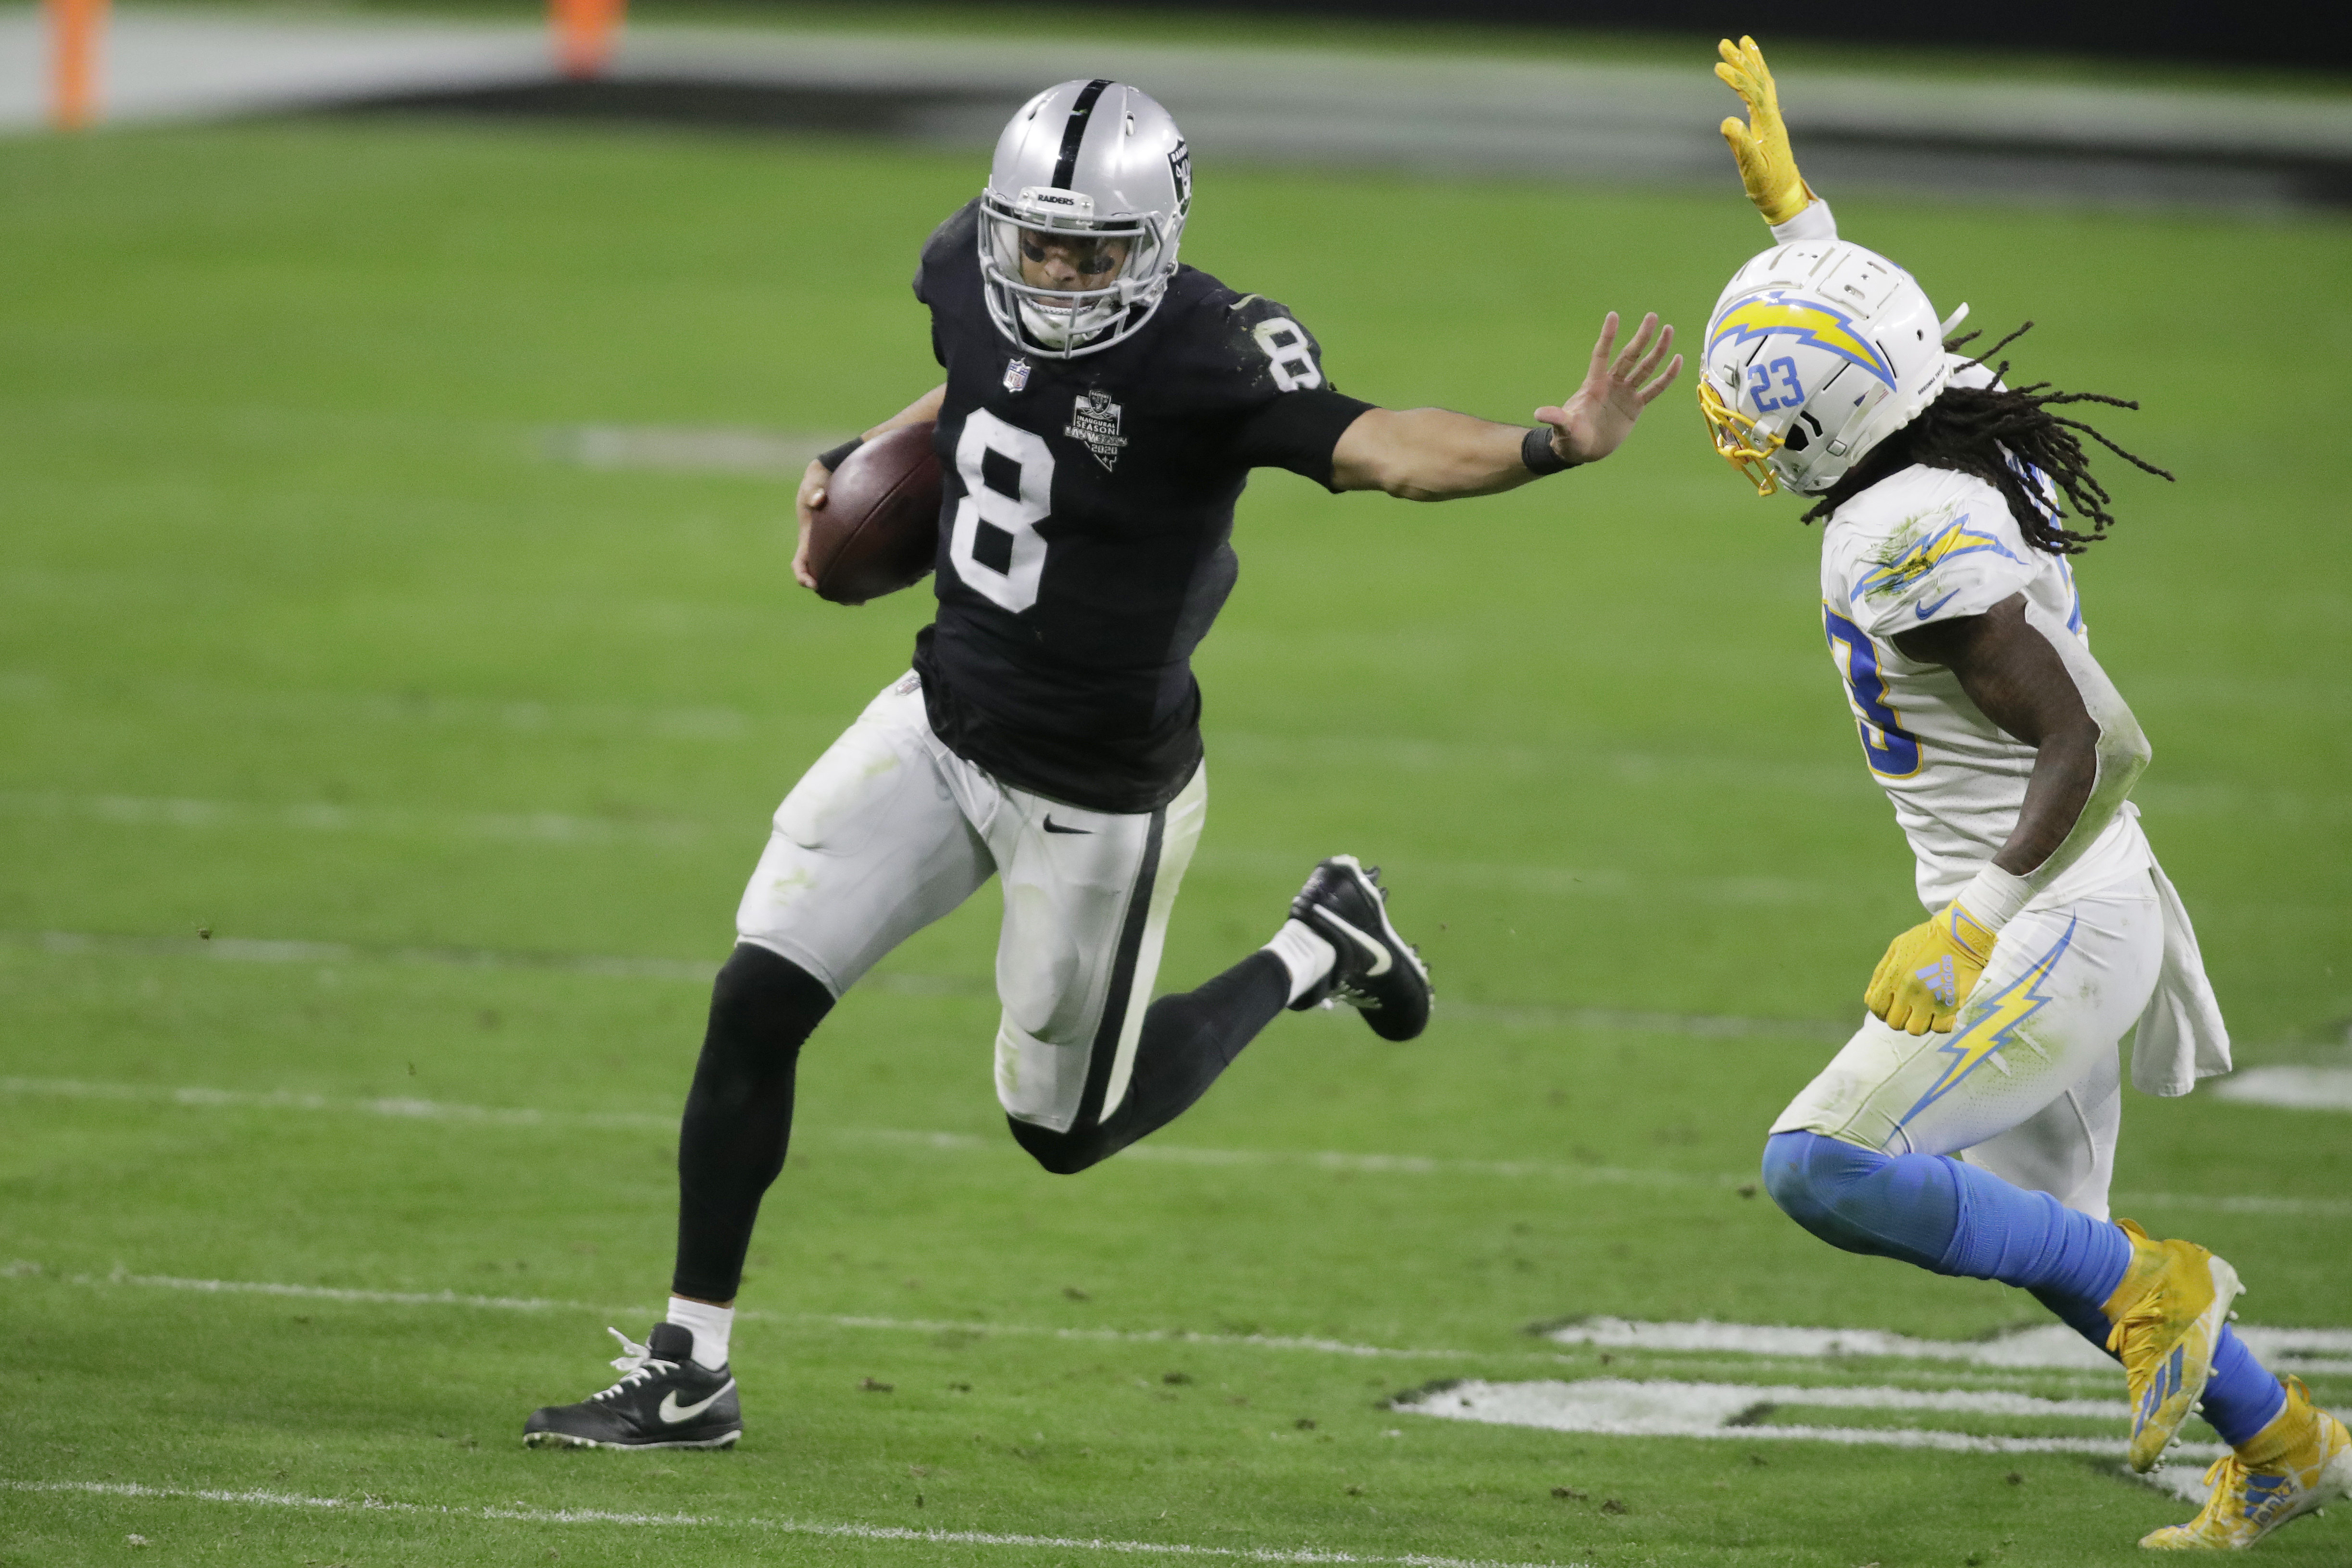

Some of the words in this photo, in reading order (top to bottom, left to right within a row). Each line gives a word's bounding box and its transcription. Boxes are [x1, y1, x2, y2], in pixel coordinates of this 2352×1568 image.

[1038, 194, 1074, 205] RAIDERS
[1254, 317, 1321, 392] 8
[1747, 356, 1805, 412] 23
[1076, 420, 1116, 435] SEASON
[1077, 415, 1116, 429] INAUGURAL
[1064, 425, 1087, 439] LAS
[1091, 444, 1118, 455] 2020
[950, 407, 1056, 614] 8
[1941, 954, 1955, 1007] adidas
